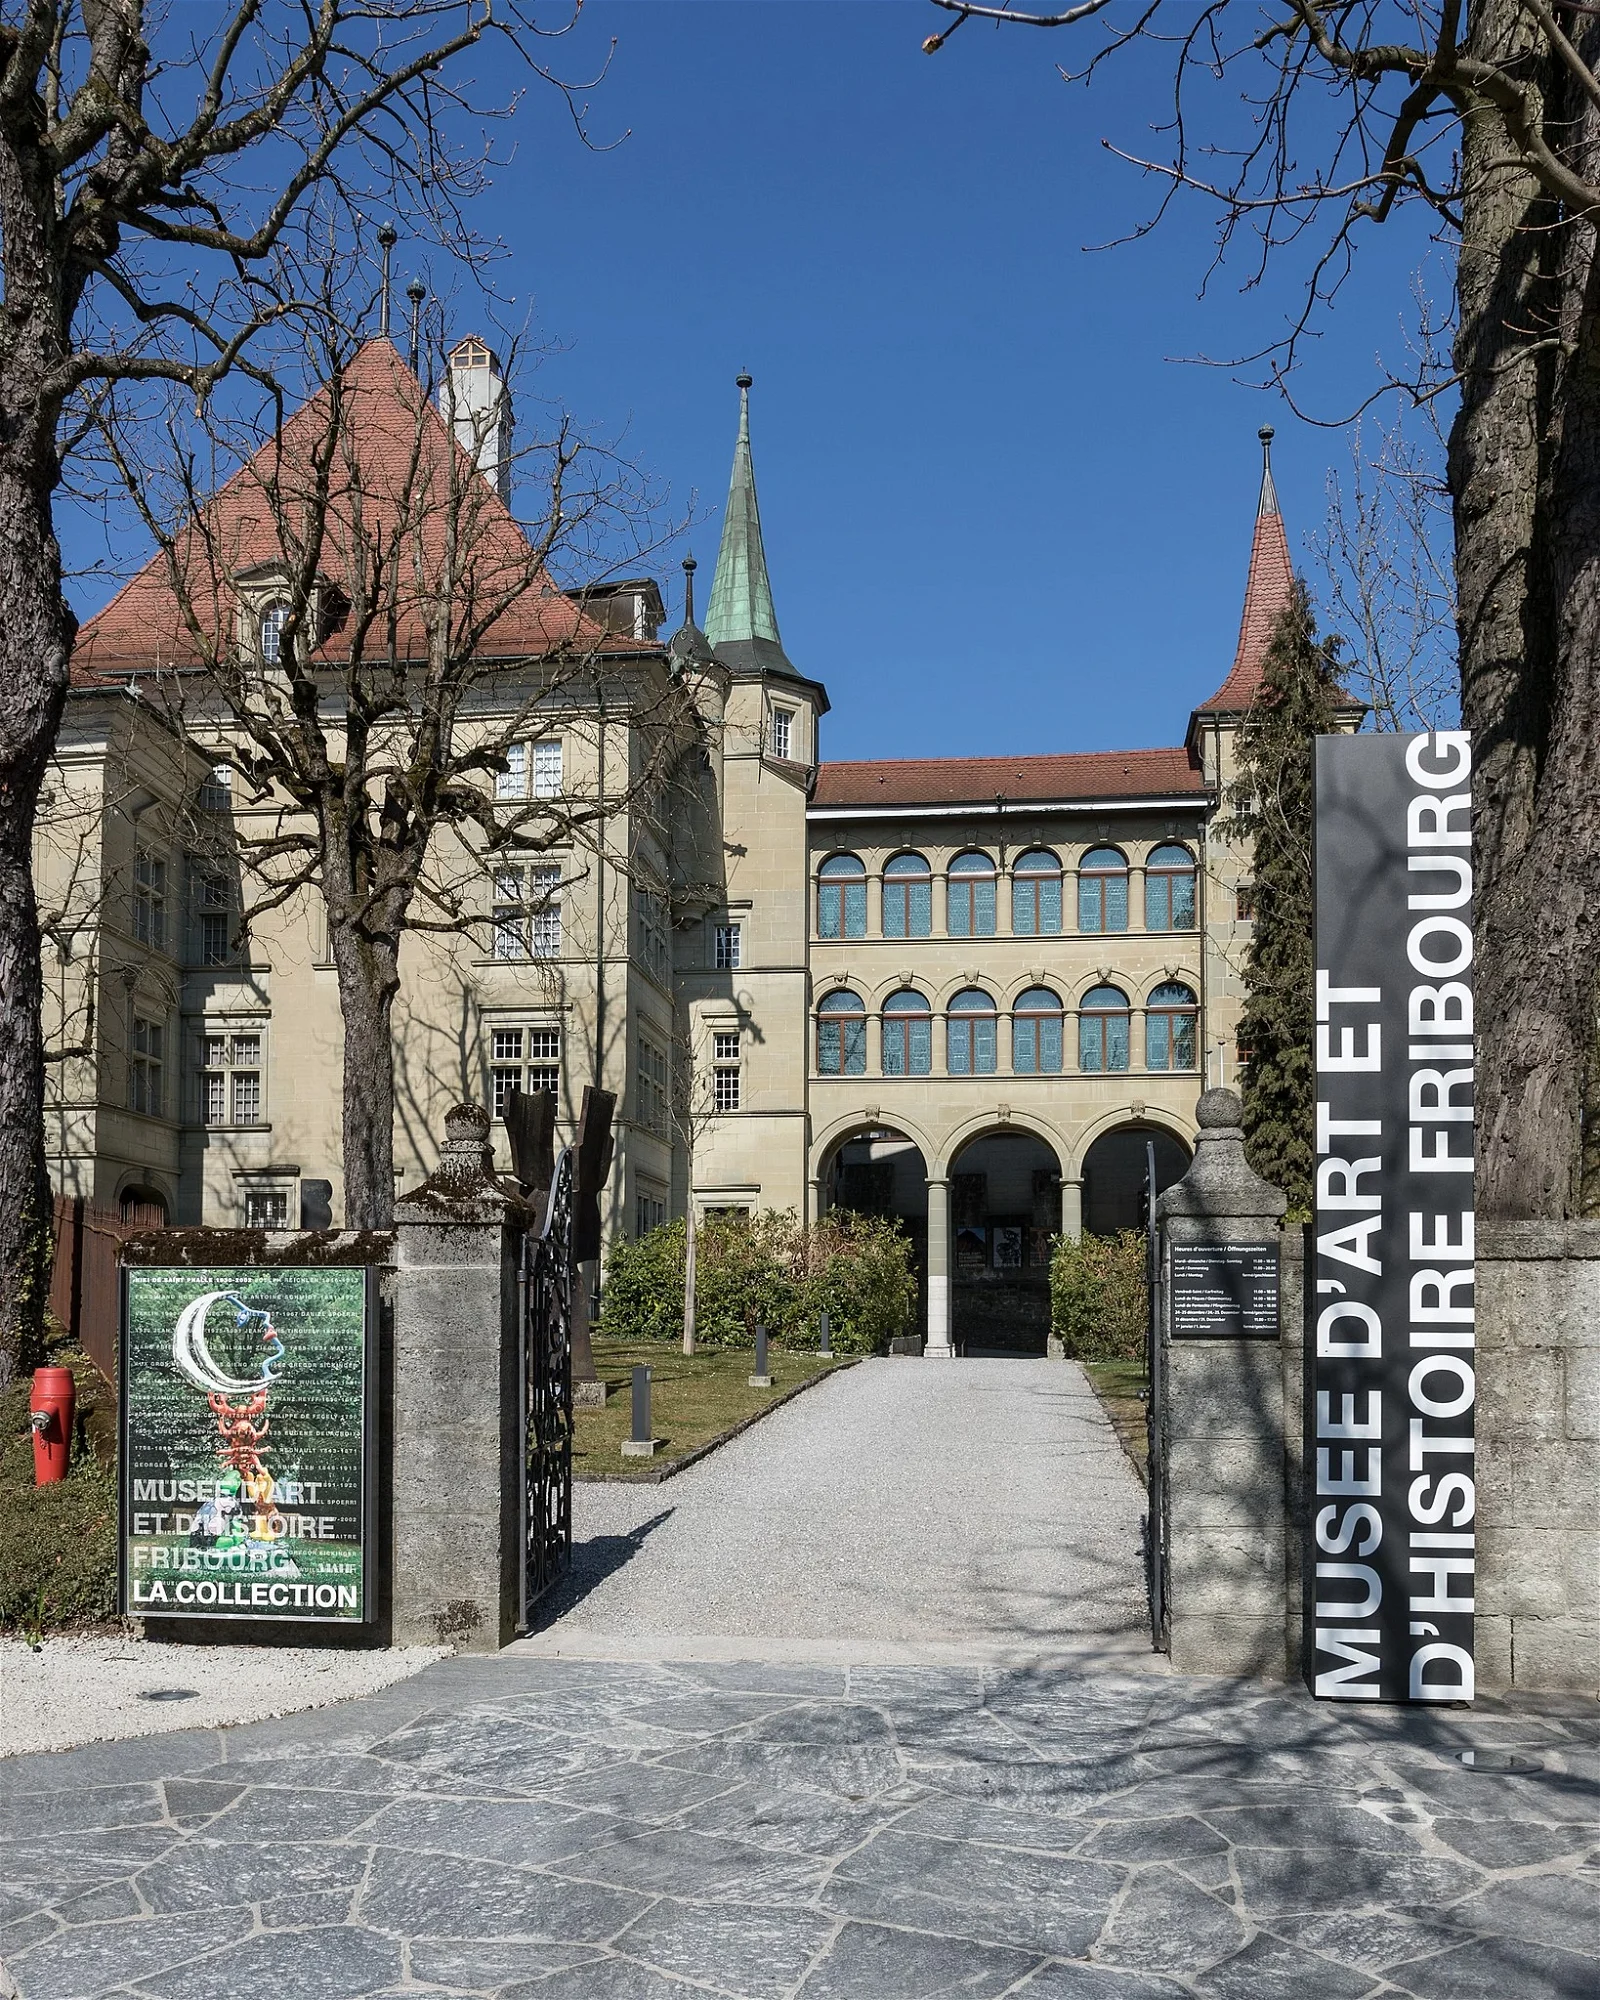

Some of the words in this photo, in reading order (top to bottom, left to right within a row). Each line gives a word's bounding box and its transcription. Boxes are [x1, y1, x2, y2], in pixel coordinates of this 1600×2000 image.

[1315, 969, 1382, 1072] ET
[1404, 730, 1475, 1172] FRIBOURG
[1316, 1101, 1382, 1358] D'ART
[134, 1513, 169, 1535] ET
[176, 1513, 335, 1539] DHISTOIRE
[1315, 1390, 1383, 1698] MUSEE
[1407, 1211, 1475, 1700] D'HISTOIRE
[134, 1546, 289, 1571] FRIBOURG
[134, 1580, 168, 1602] LA
[176, 1580, 357, 1608] COLLECTION
